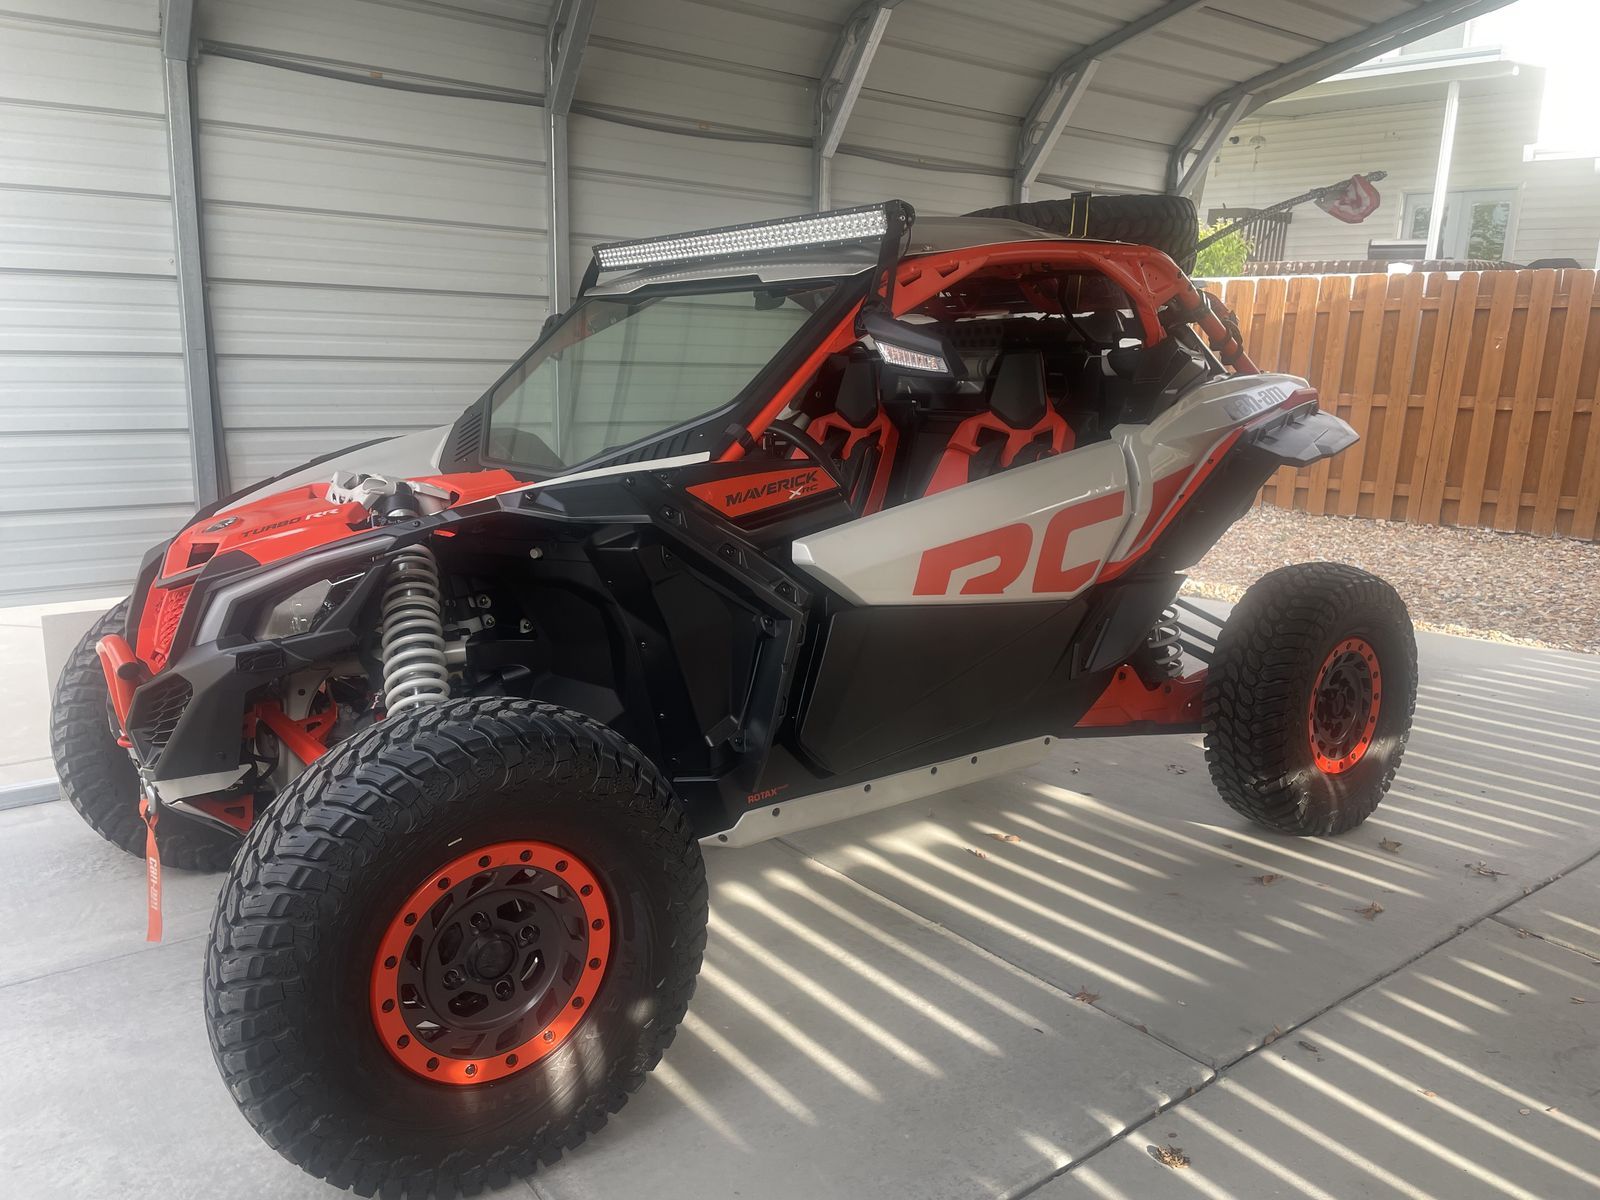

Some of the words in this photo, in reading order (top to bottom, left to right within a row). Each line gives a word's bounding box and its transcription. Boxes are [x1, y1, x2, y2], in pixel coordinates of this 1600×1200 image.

[725, 470, 817, 506] MAVERICK
[242, 516, 301, 537] TURBO
[305, 508, 339, 521] RR
[912, 490, 1125, 596] RC
[747, 788, 778, 804] ROTAX
